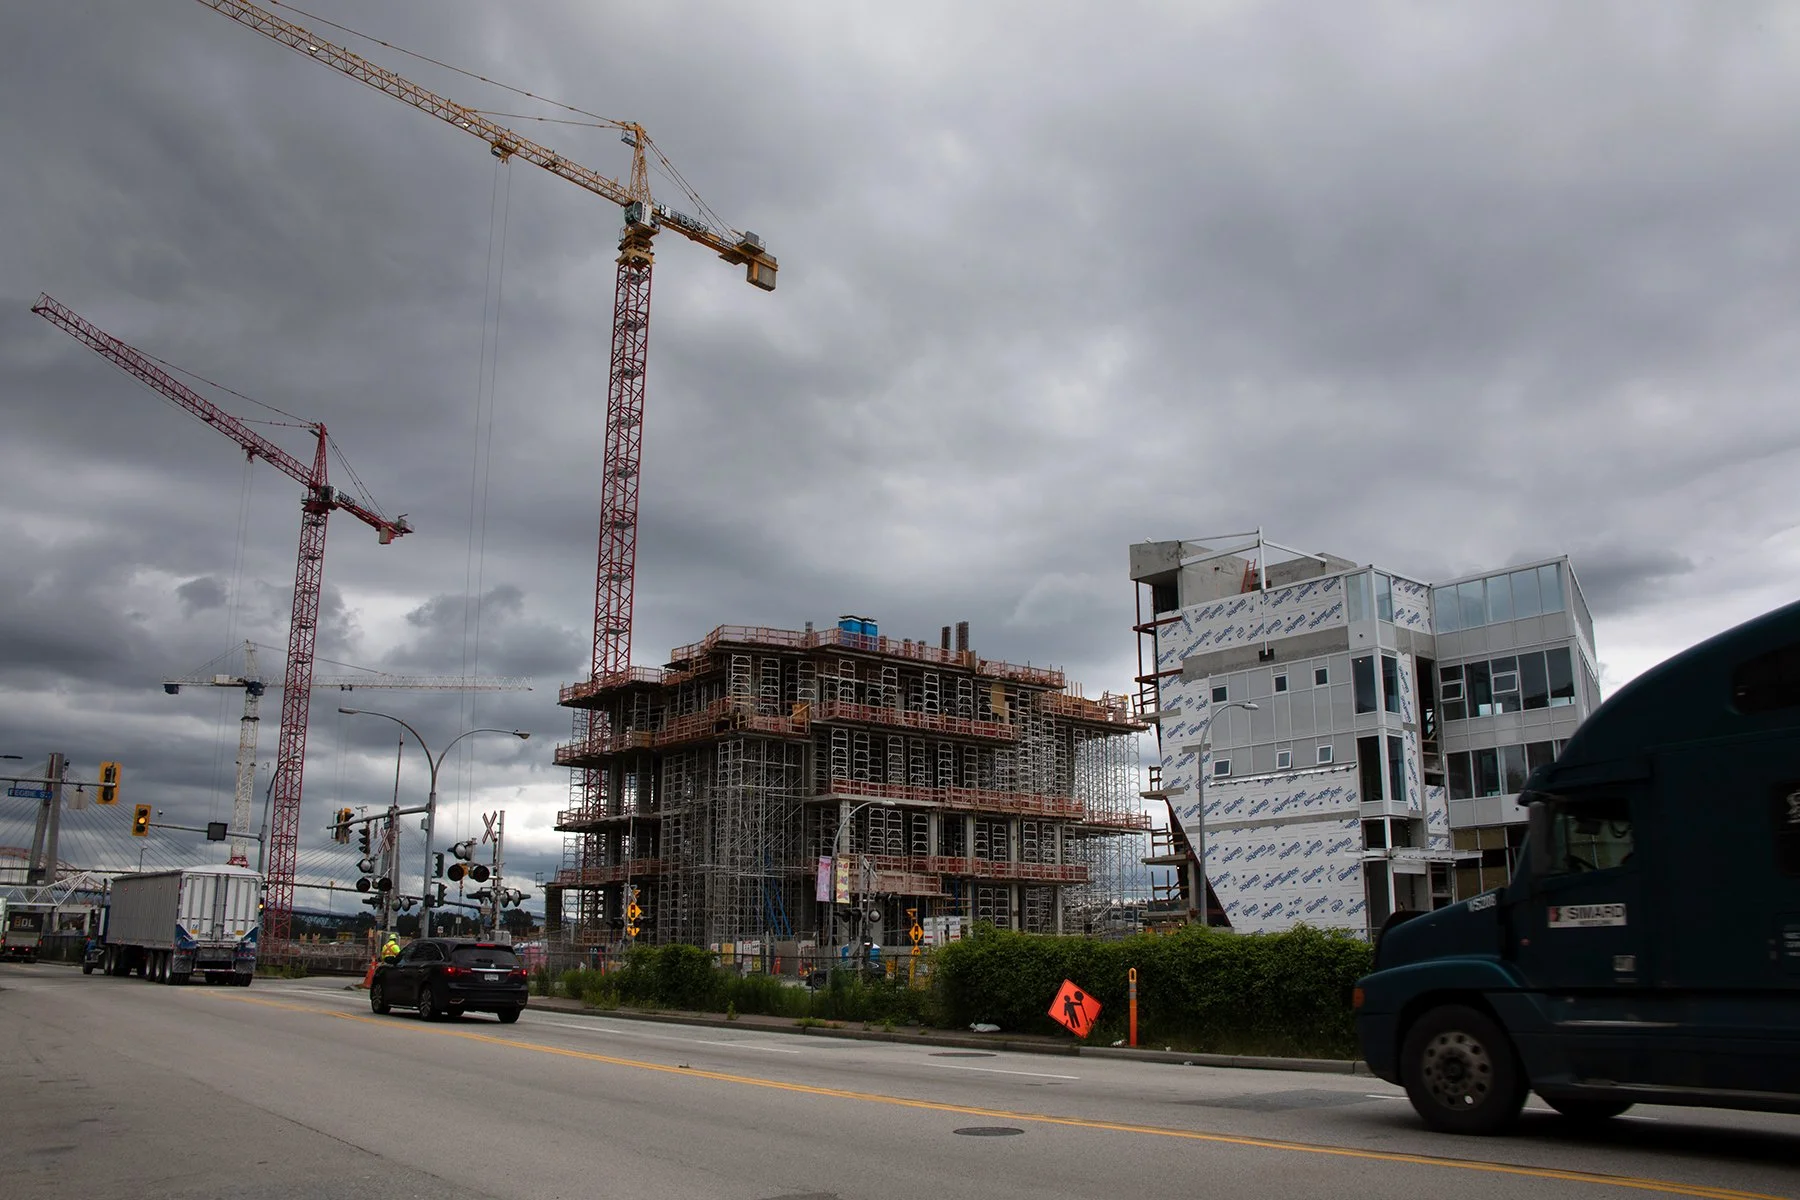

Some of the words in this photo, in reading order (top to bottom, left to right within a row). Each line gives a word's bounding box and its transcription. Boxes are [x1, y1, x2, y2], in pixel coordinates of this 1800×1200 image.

[1271, 589, 1292, 608] GlasRoc
[1284, 614, 1305, 634] GlasRoc
[1167, 721, 1186, 738] GlasRoc
[1175, 752, 1195, 769] GlasRoc
[1224, 796, 1245, 815] GlasRoc
[1248, 799, 1269, 817] GlasRoc
[1222, 847, 1243, 864] GlasRoc
[1245, 845, 1267, 862] GlasRoc
[1279, 842, 1300, 860] GlasRoc
[1302, 865, 1324, 883] GlasRoc
[1338, 863, 1361, 881] GlasRoc
[1239, 874, 1260, 892] GlasRoc
[1261, 903, 1283, 920] GlasRoc
[1306, 896, 1328, 913] GlasRoc
[1568, 905, 1625, 919] SIMARD
